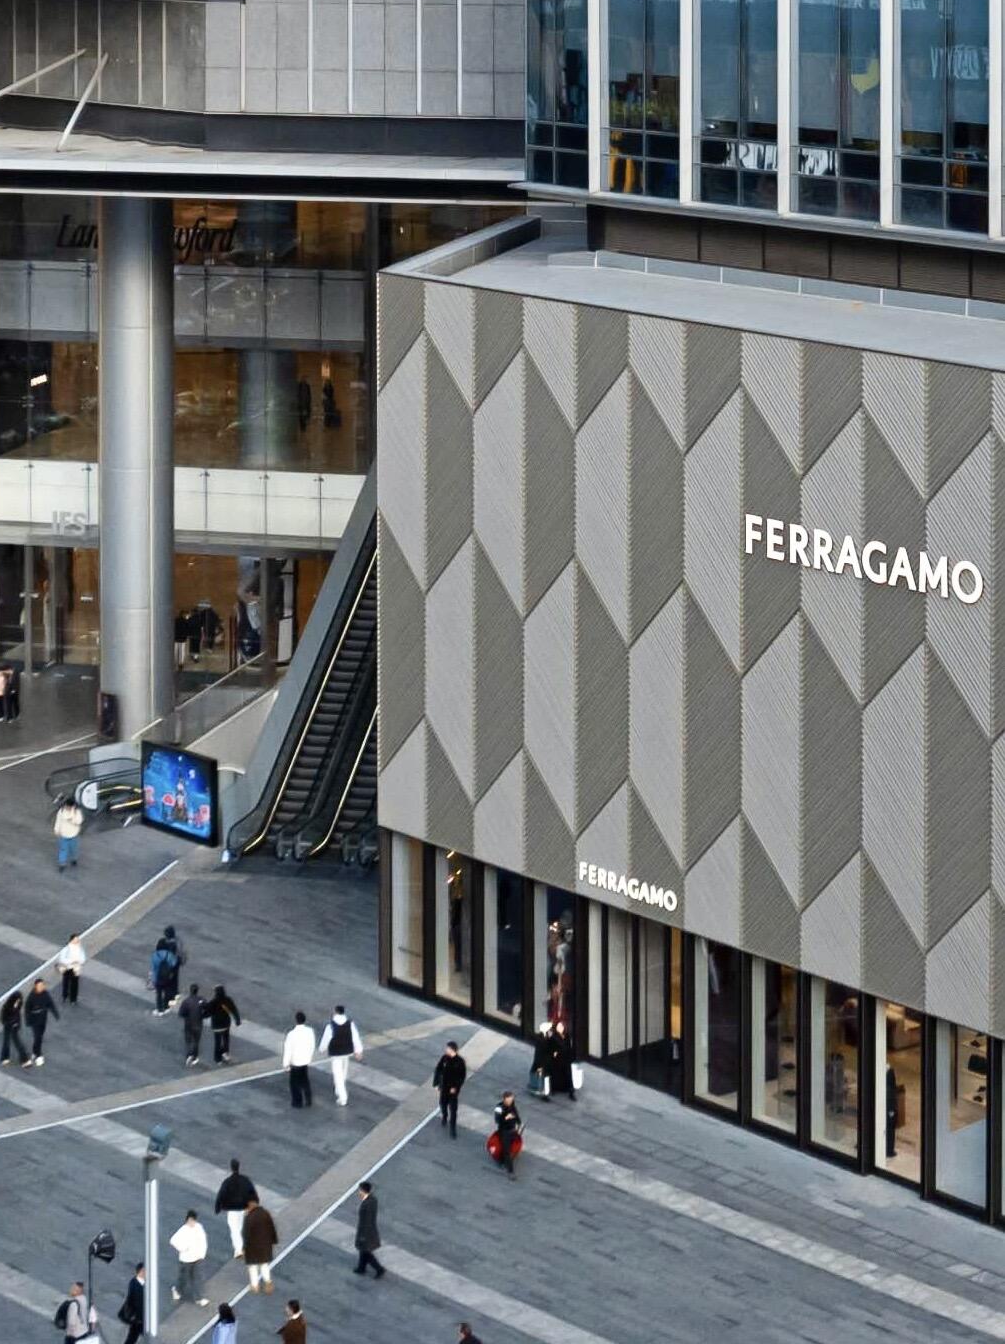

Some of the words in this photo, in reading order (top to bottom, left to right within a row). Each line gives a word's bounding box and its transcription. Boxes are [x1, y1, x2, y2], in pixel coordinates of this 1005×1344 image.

[52, 511, 87, 537] IFS
[745, 513, 984, 604] FERRAGAMO
[579, 861, 678, 912] FERRAGAMO
